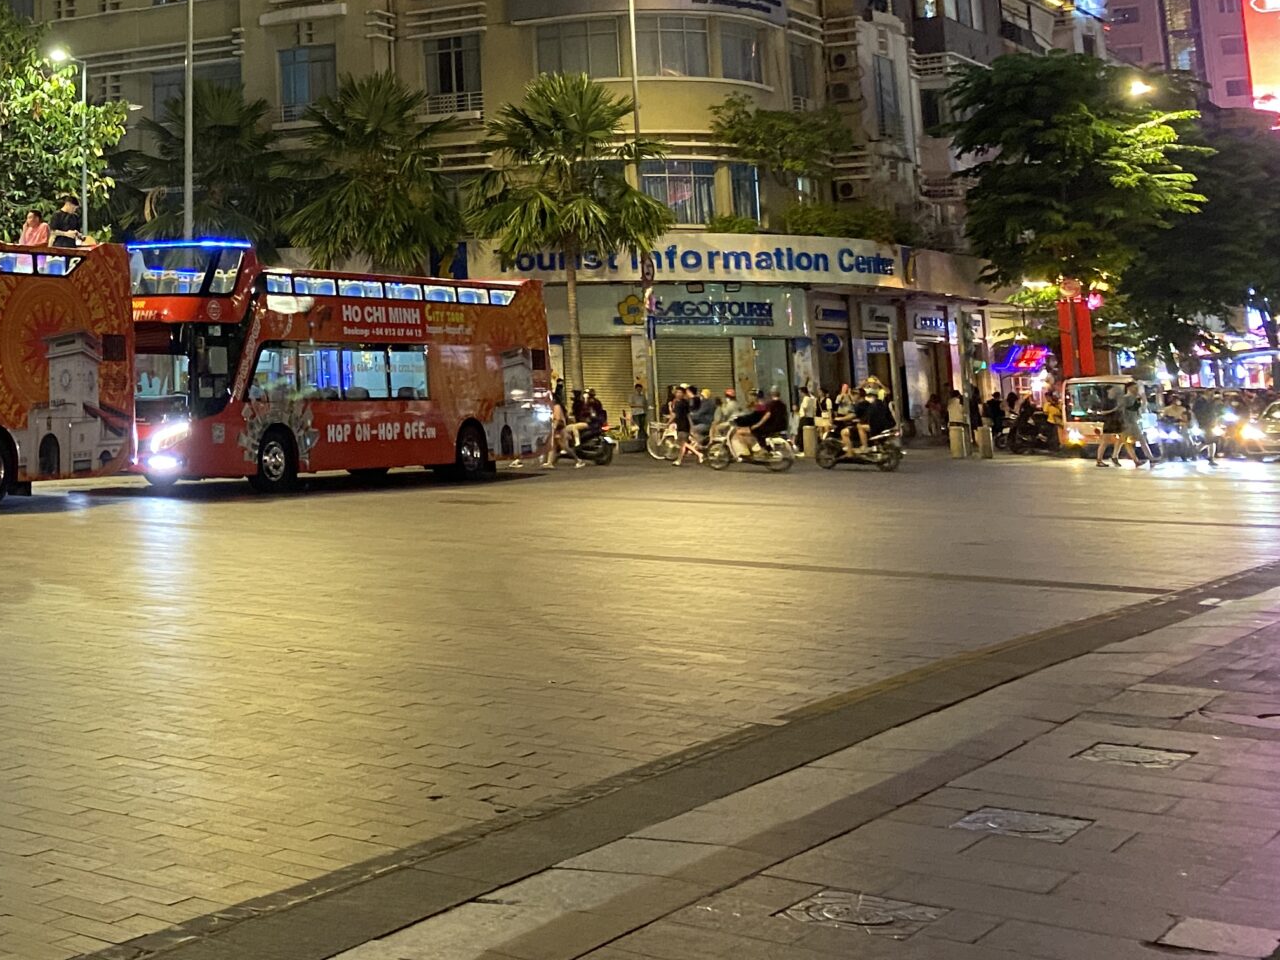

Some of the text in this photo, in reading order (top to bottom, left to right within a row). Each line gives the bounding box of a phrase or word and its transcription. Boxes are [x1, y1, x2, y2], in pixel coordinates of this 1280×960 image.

[342, 304, 421, 324] HO CHI MINH
[327, 423, 351, 443] HOP
